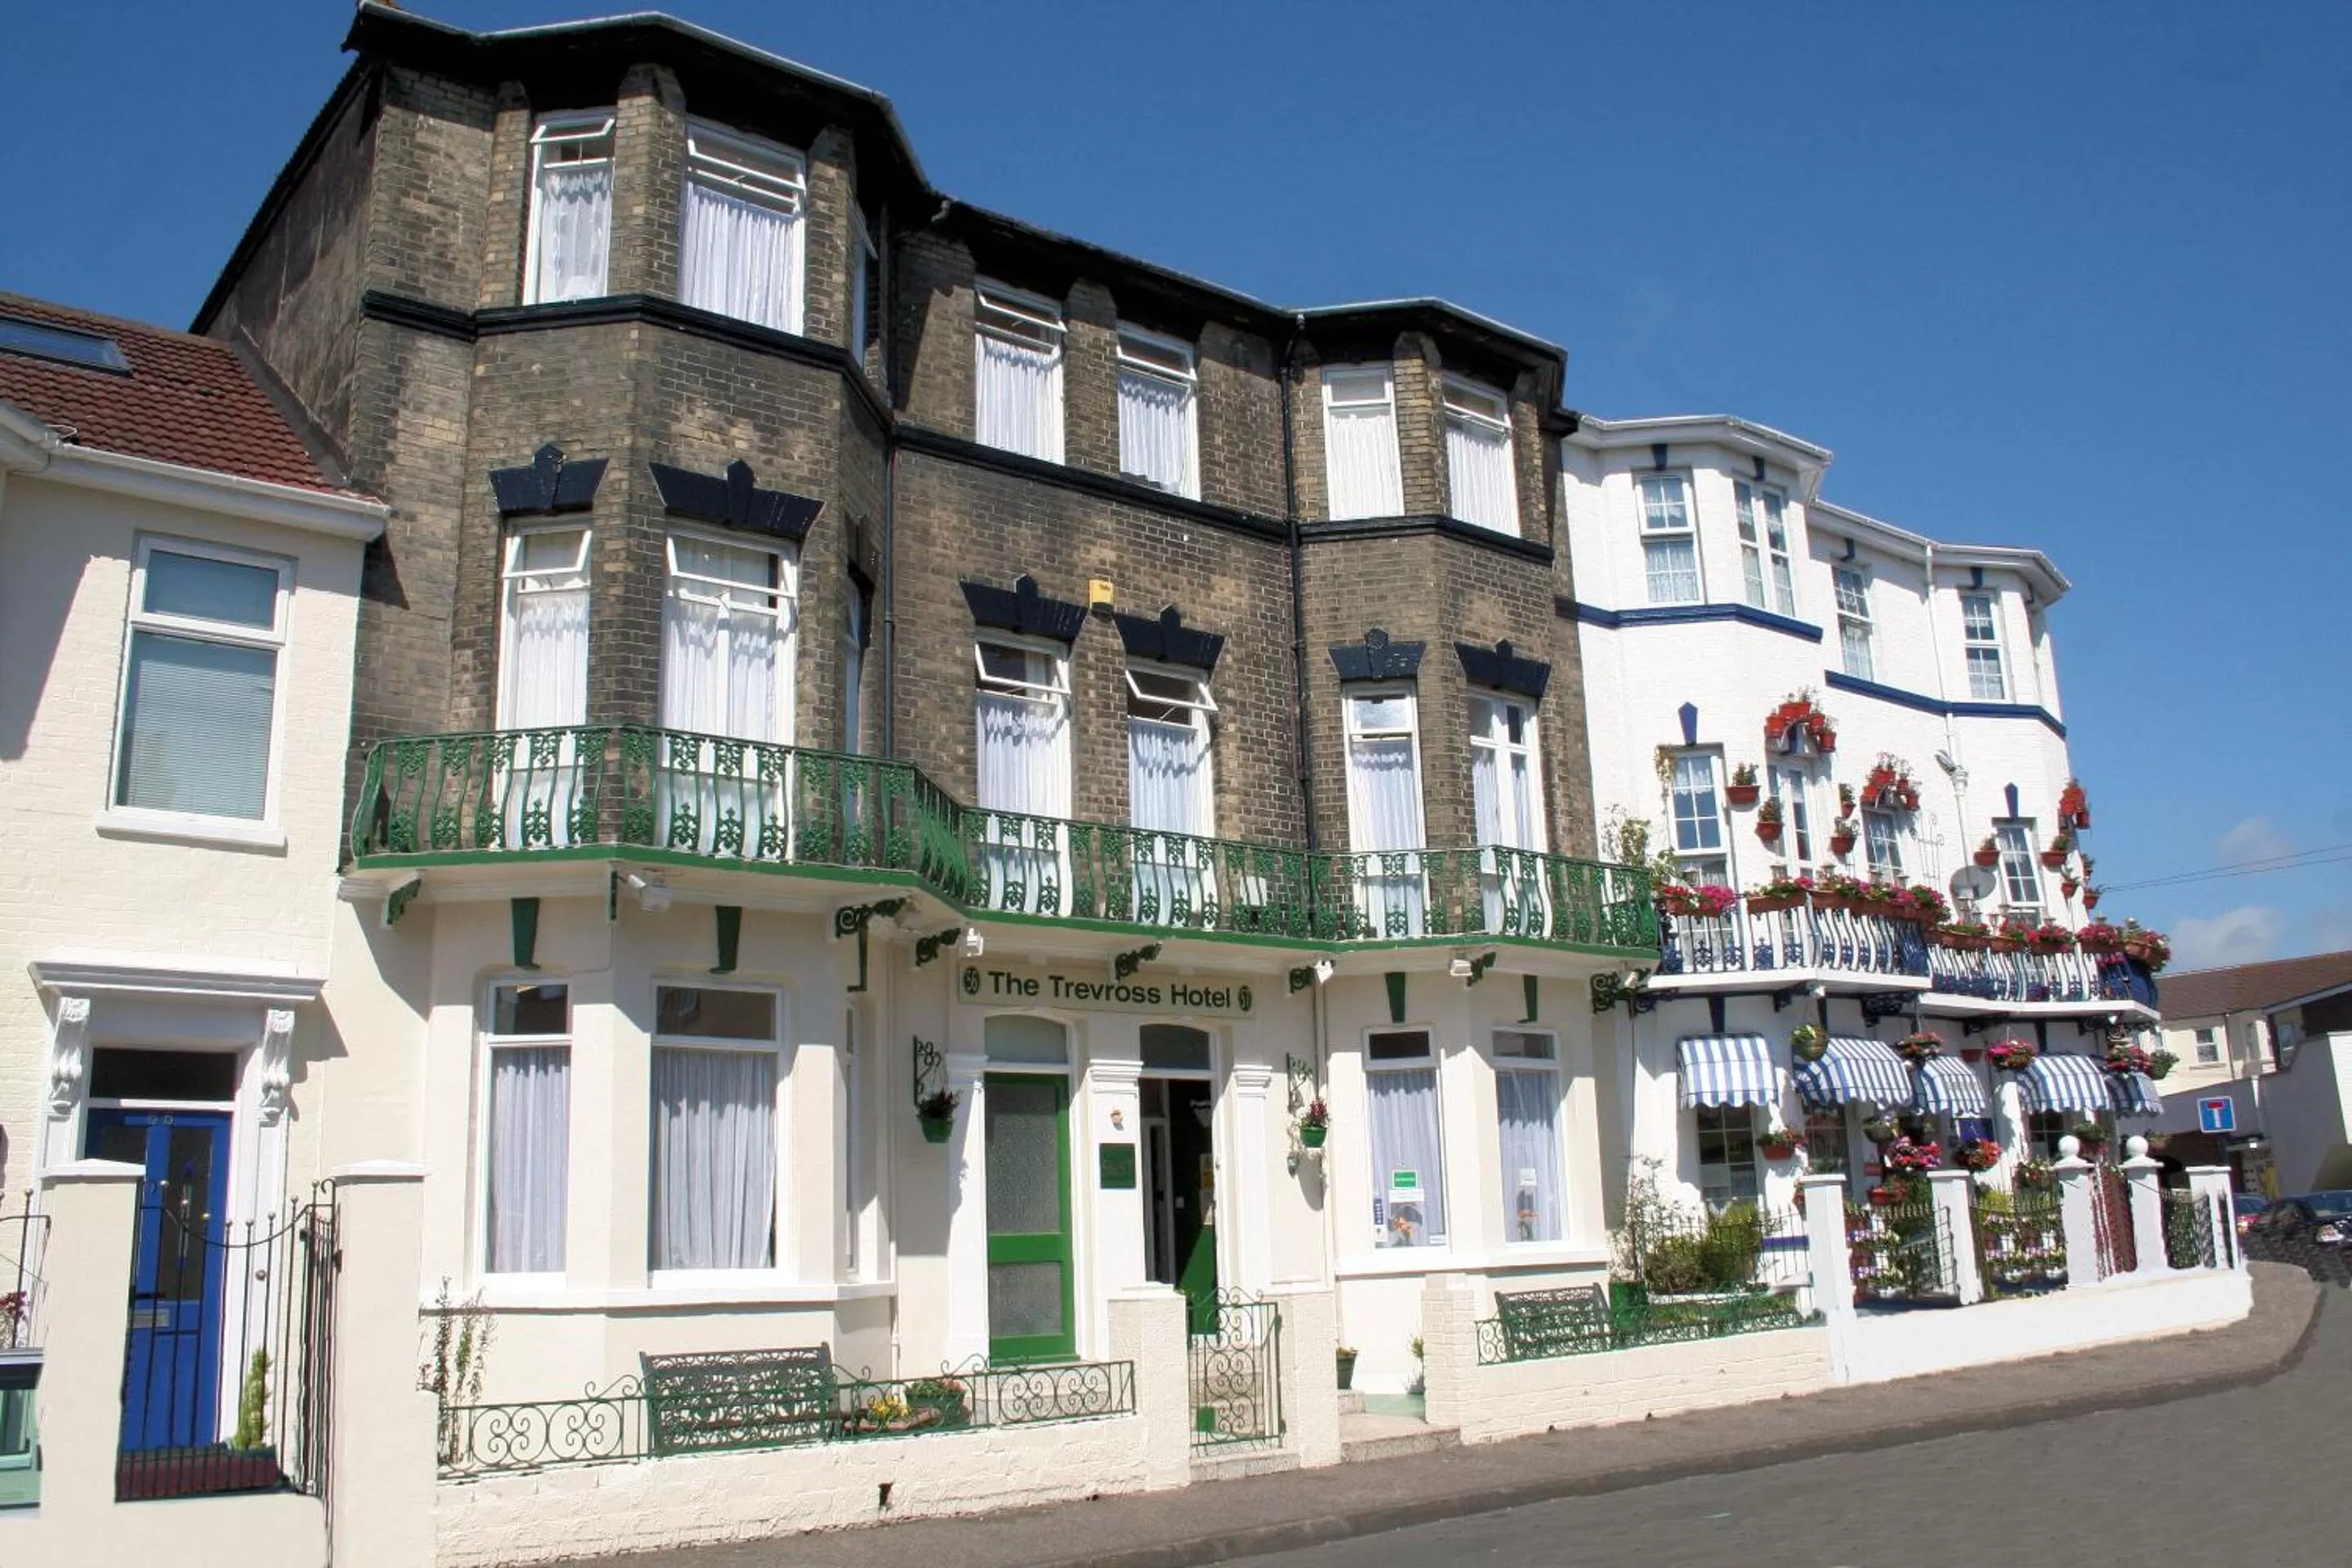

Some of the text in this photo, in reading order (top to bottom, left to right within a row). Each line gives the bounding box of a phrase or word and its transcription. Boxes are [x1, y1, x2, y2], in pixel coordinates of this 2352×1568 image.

[987, 971, 1040, 996] The
[1048, 975, 1161, 1004] Trevross
[1170, 983, 1231, 1009] Hotel
